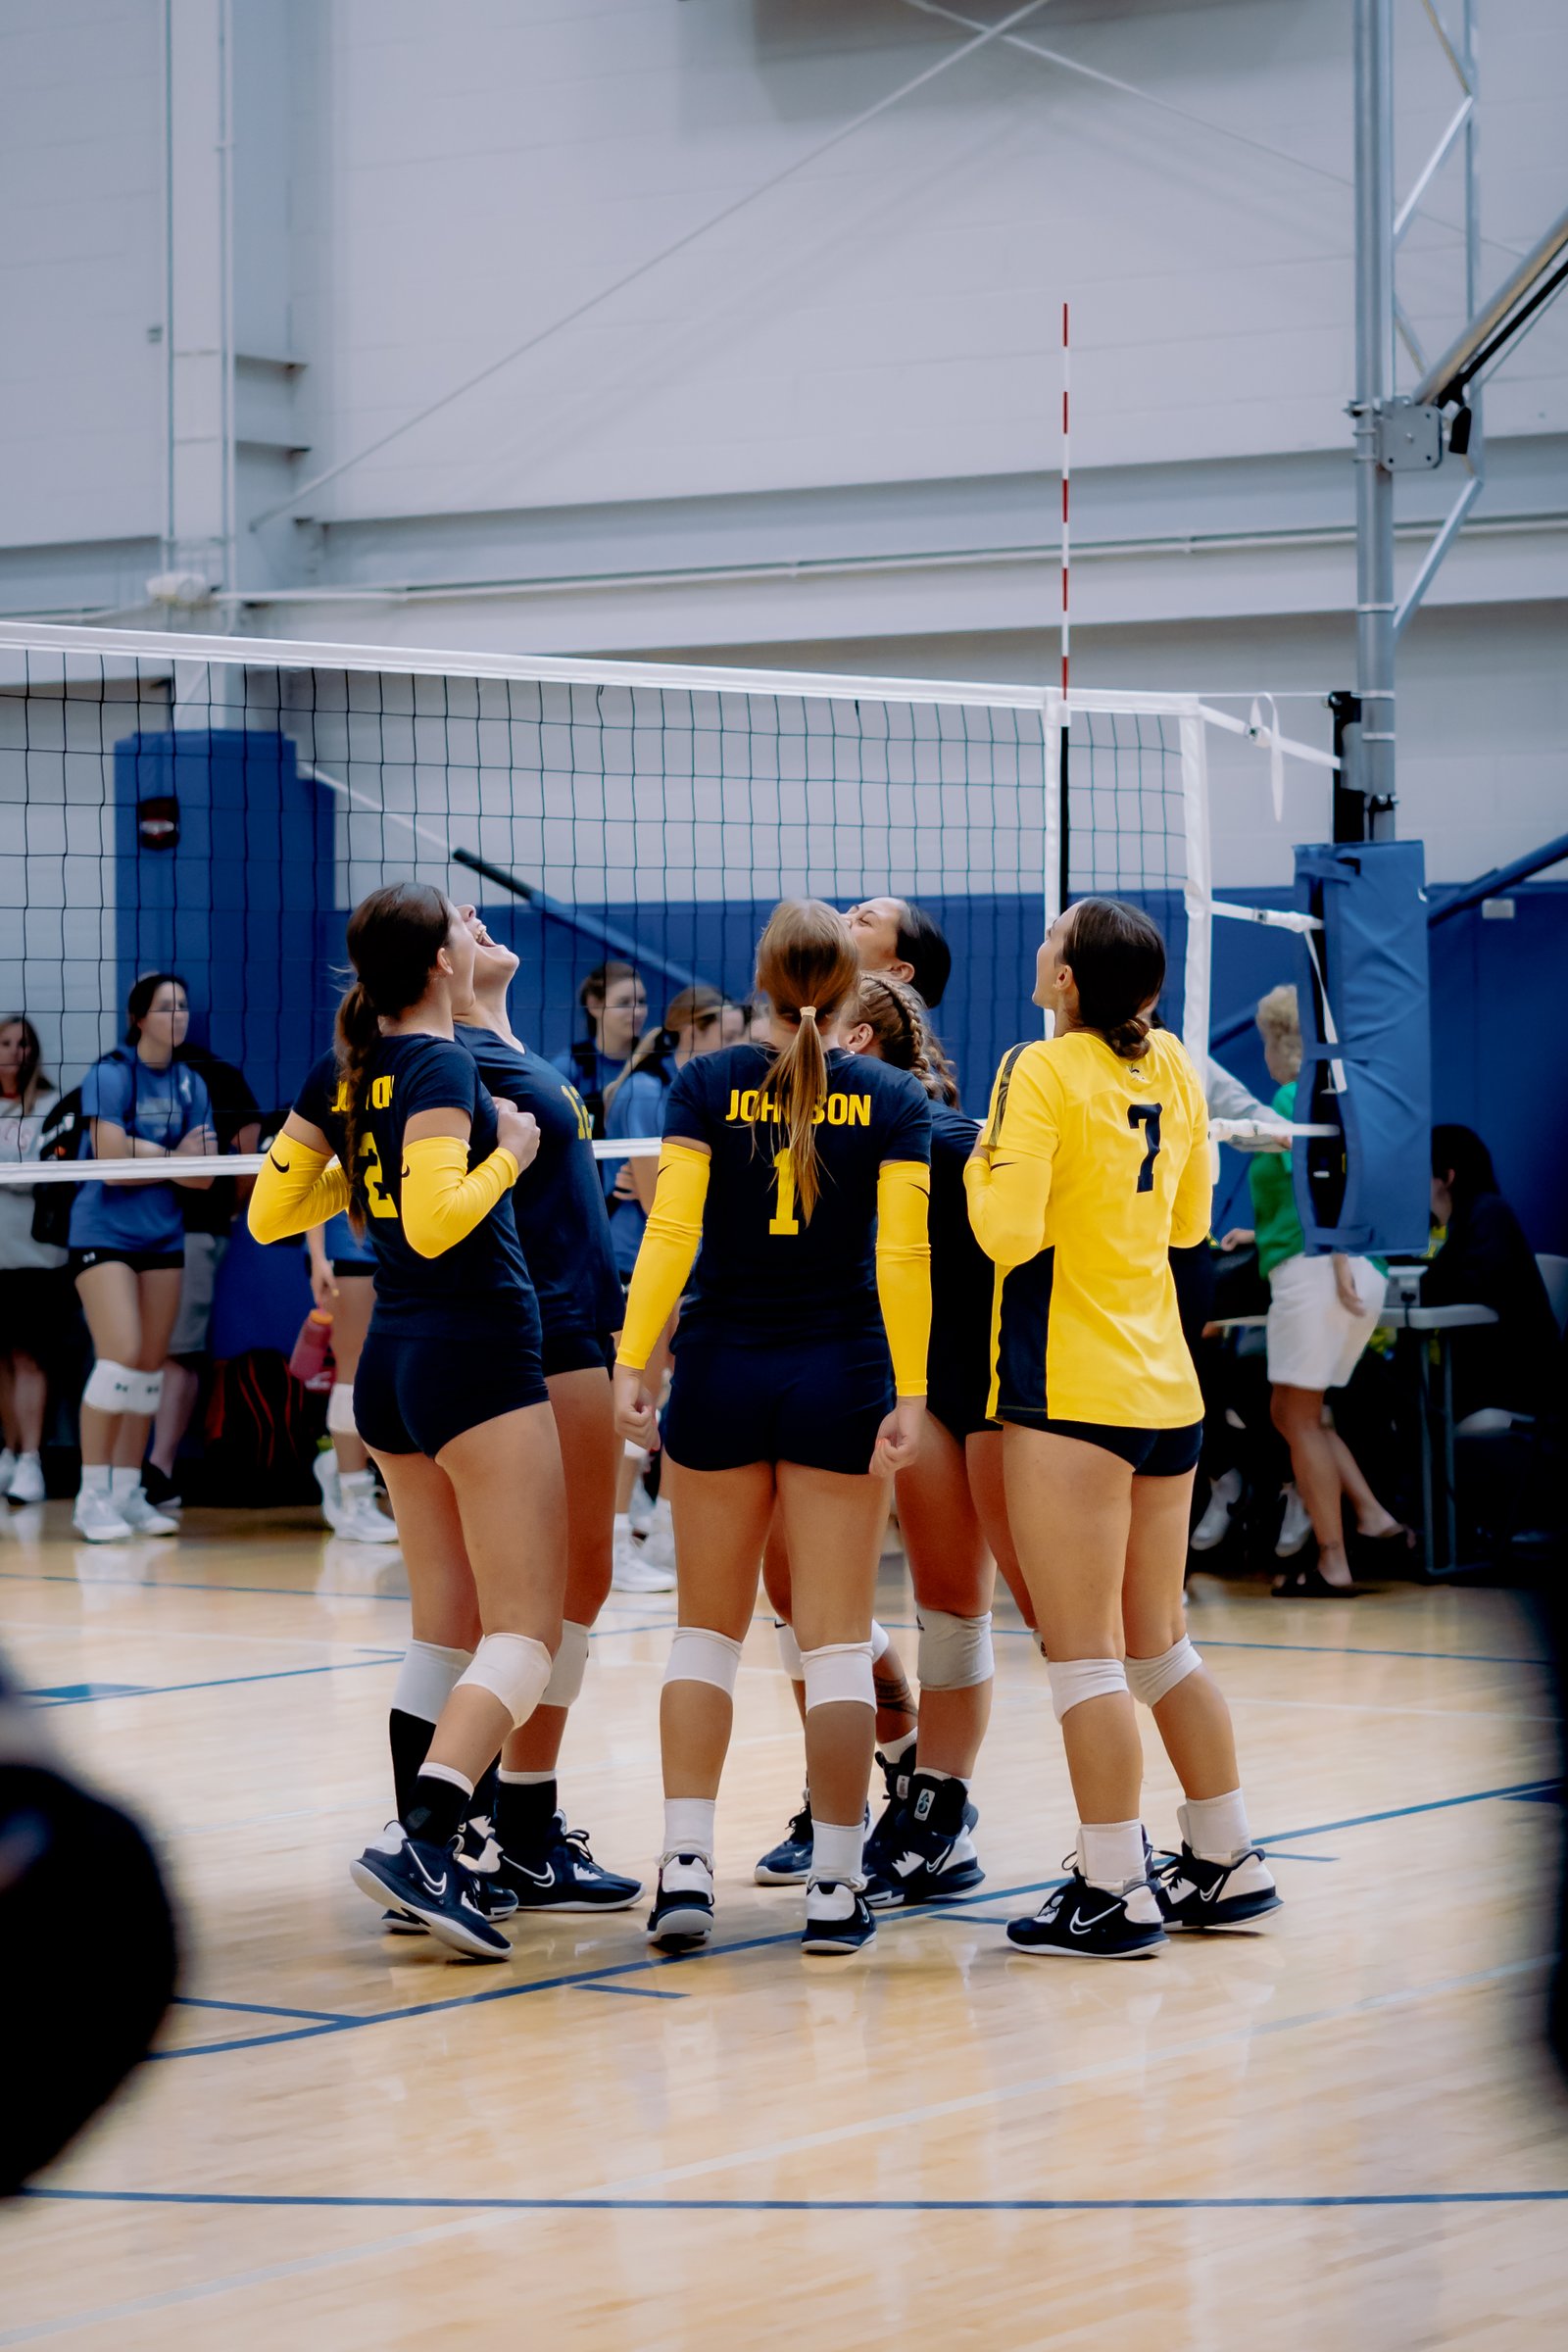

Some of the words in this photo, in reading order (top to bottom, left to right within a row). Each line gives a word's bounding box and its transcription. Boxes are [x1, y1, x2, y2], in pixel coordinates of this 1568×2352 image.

[725, 1089, 871, 1126] JOHSON
[1127, 1102, 1163, 1194] 7
[359, 1132, 399, 1218] 2
[769, 1148, 799, 1236] 1
